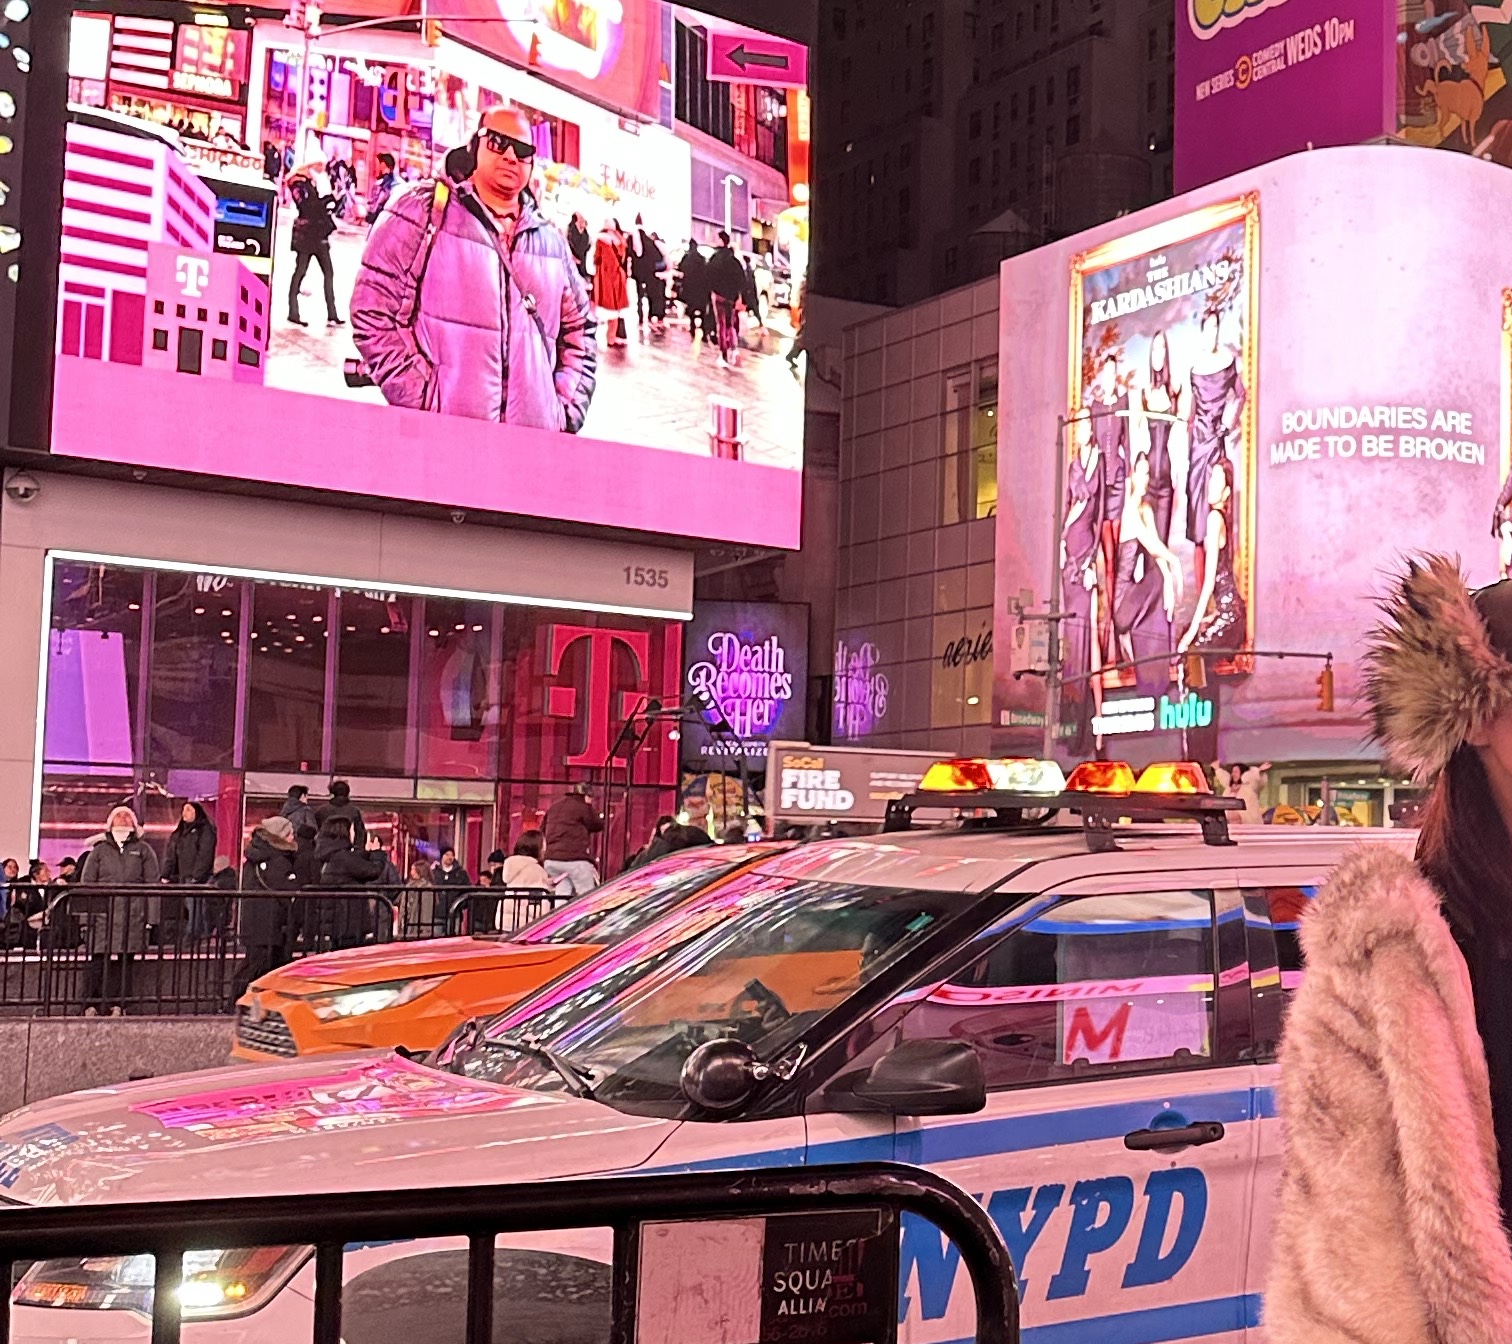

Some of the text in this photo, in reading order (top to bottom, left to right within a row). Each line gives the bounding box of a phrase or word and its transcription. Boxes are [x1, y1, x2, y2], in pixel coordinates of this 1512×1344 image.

[1286, 17, 1355, 66] WEDS 10PM
[1090, 259, 1231, 325] KARDASHIANS
[1281, 405, 1473, 435] BOUNDARIES ARE
[1270, 434, 1485, 466] MADE TO BE BROKEN
[621, 565, 670, 589] 1535
[708, 632, 784, 673] Death
[721, 697, 775, 738] Her
[1159, 692, 1213, 730] hulu
[781, 769, 841, 790] FIRE
[782, 756, 824, 770] SoCal
[781, 789, 855, 811] FUND
[898, 1166, 1209, 1324] NYPD
